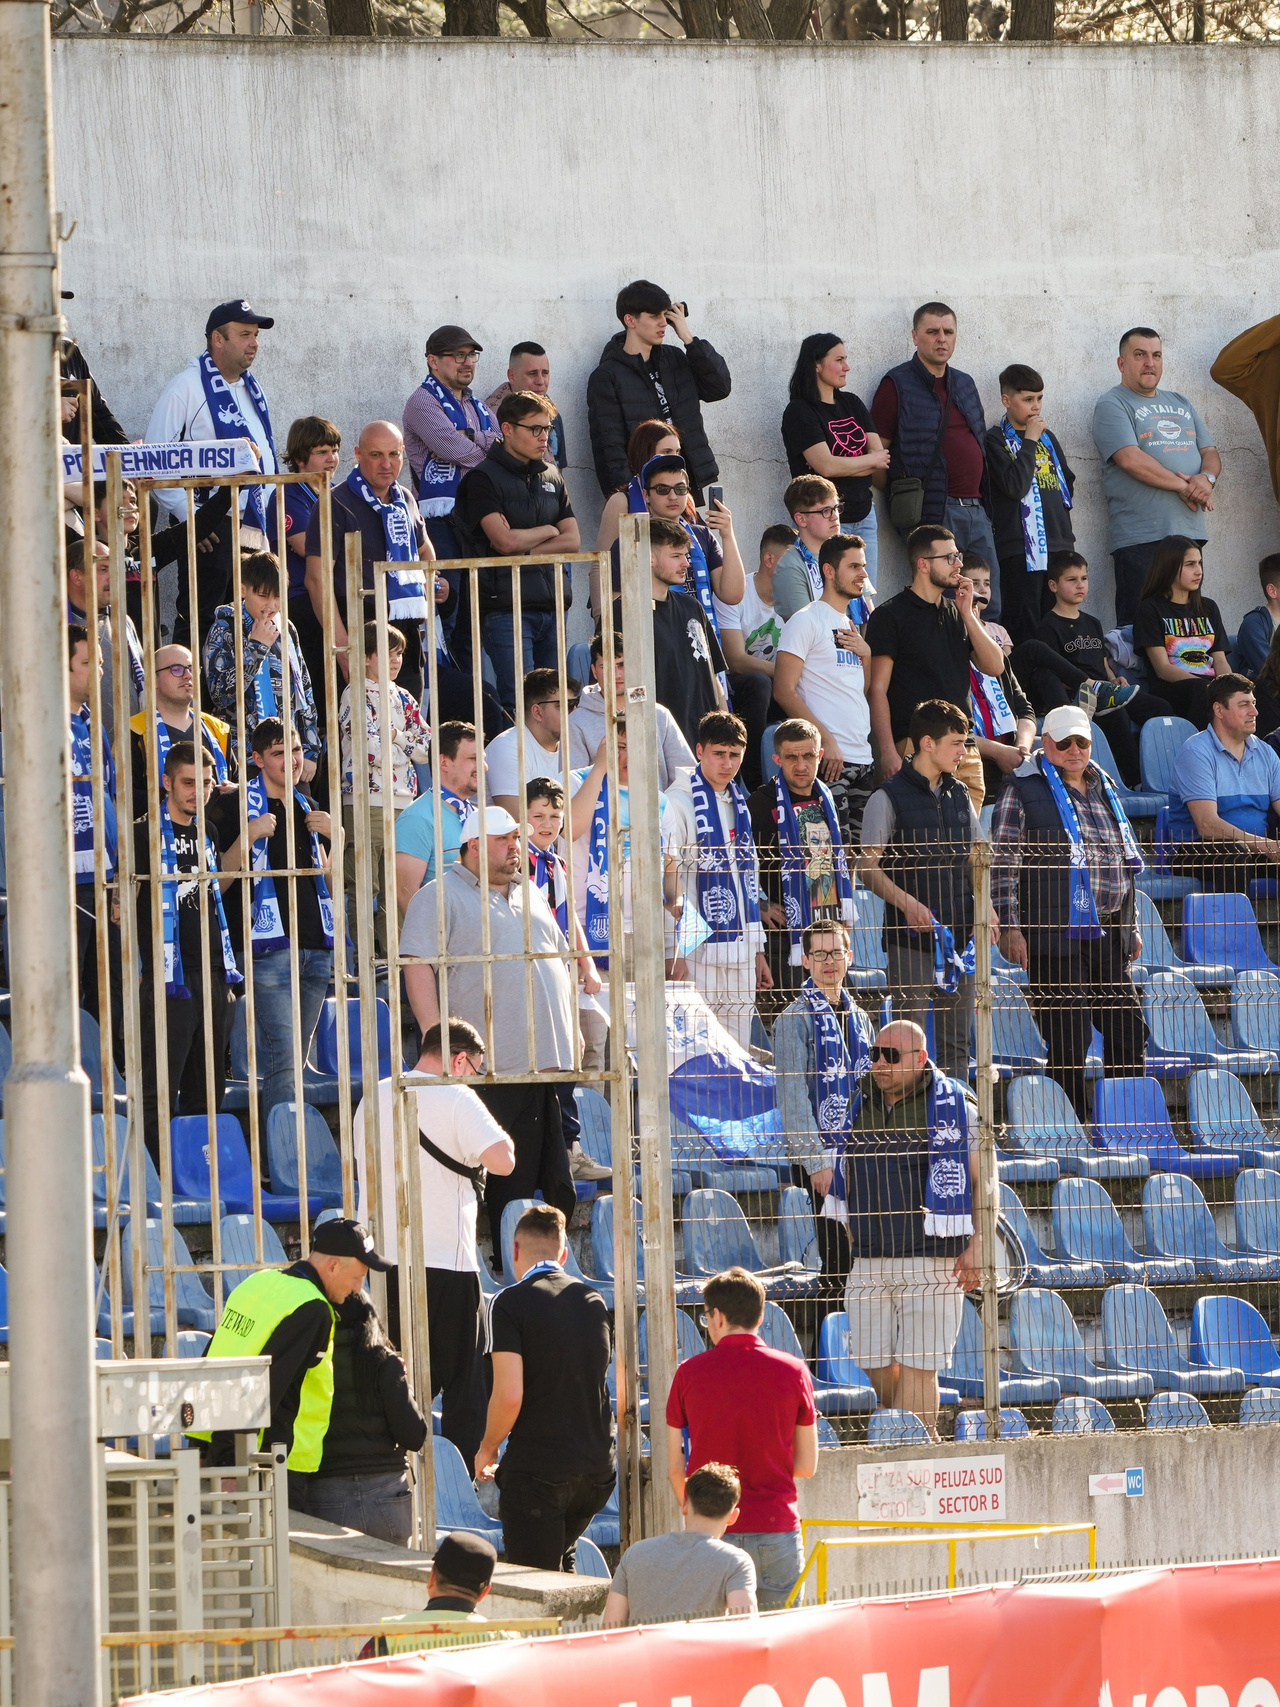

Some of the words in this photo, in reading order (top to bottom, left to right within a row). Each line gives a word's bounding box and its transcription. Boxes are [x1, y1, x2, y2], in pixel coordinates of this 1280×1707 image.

[1134, 405, 1152, 421] TOM
[1151, 404, 1192, 420] TAILOR
[64, 448, 193, 475] POIEHNICA
[199, 447, 236, 469] IASI
[1162, 617, 1215, 637] NIRVANA
[221, 1308, 256, 1338] TEWARD
[933, 1469, 976, 1489] PELUZA
[979, 1467, 1003, 1485] SUD
[1127, 1474, 1142, 1489] WC
[939, 1494, 988, 1515] SECTOR
[991, 1493, 1000, 1511] B
